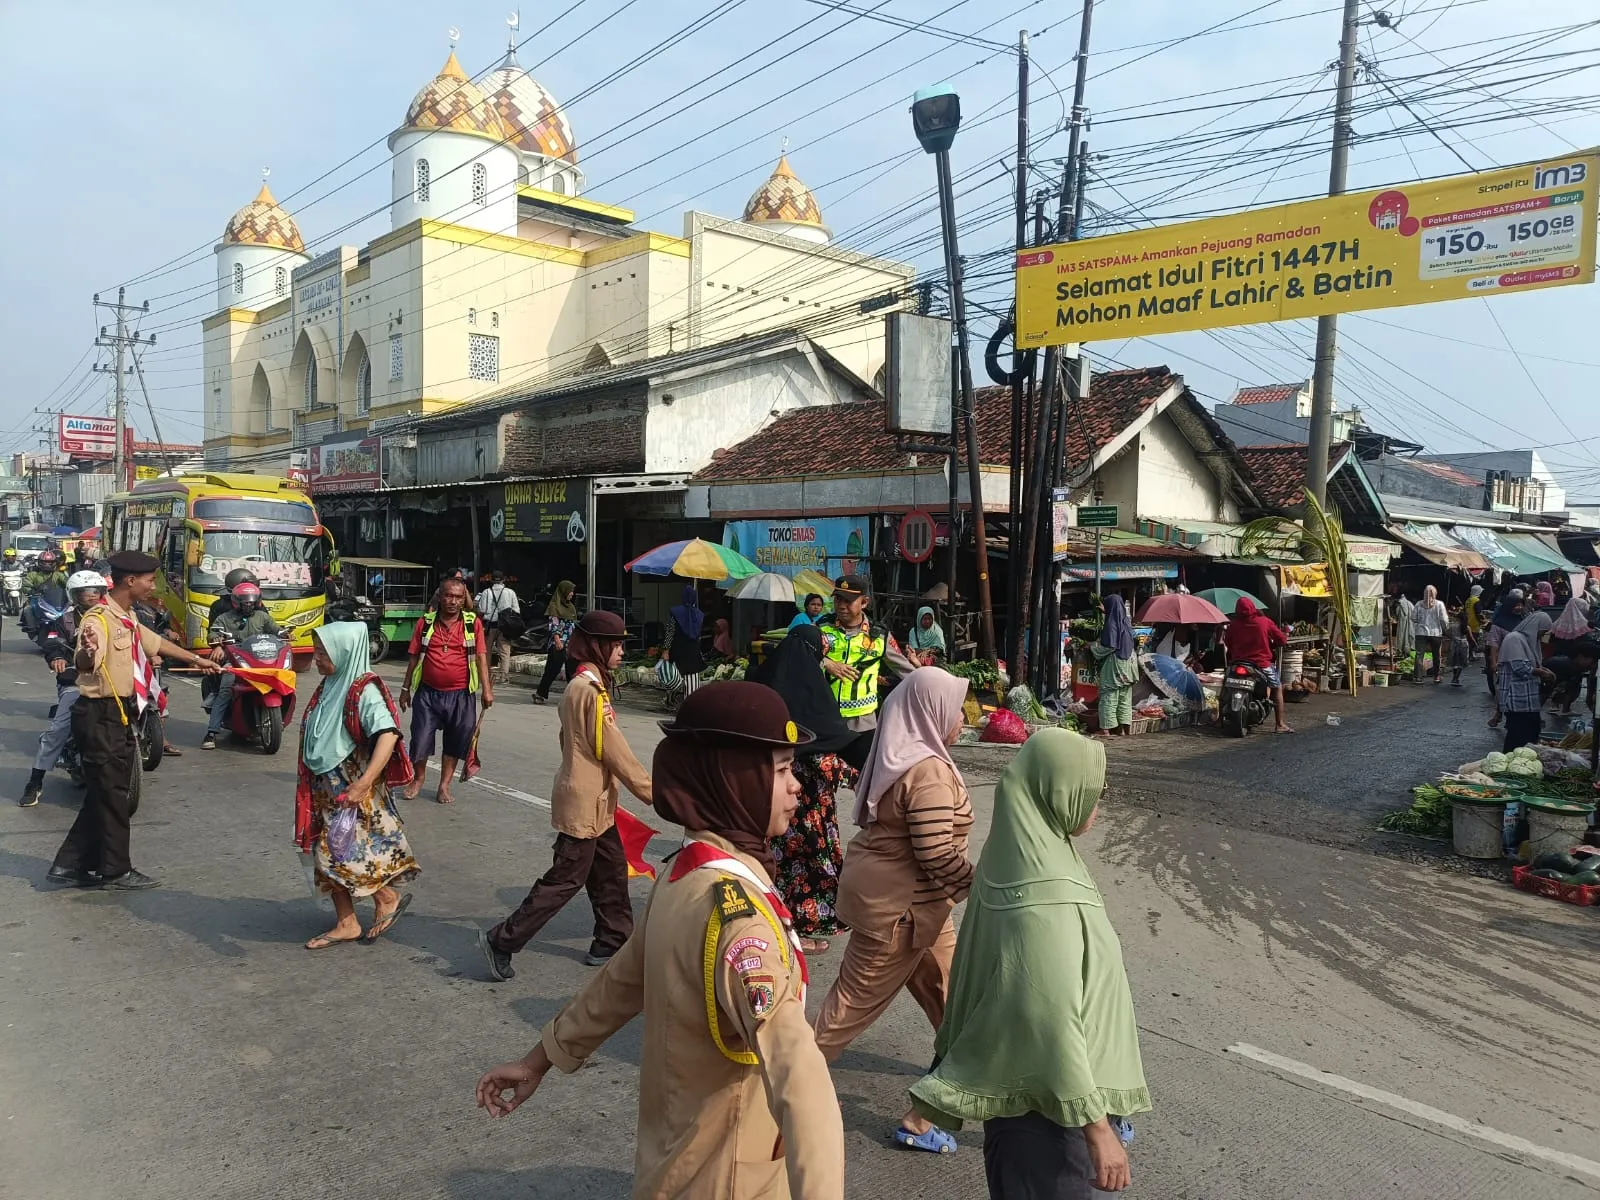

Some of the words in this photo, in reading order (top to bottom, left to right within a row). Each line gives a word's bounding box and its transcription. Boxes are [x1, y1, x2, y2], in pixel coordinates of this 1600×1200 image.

[1478, 181, 1513, 194] Simpel
[1515, 178, 1529, 188] itu
[1555, 193, 1580, 203] Baru!
[1428, 216, 1451, 225] Paket
[1452, 209, 1492, 220] Ramadan
[1493, 200, 1542, 214] SATSPAM+
[1508, 219, 1549, 243] 150
[1550, 215, 1575, 229] GB
[1057, 265, 1076, 274] IM3
[1079, 255, 1138, 272] SATSPAM+
[1141, 245, 1197, 262] Amankan
[1201, 235, 1253, 253] Pejuang
[1256, 225, 1321, 243] Ramadan
[1426, 237, 1435, 245] Rp
[1437, 231, 1485, 257] 150
[1056, 269, 1152, 301] Selamat
[1159, 260, 1203, 287] Idul
[1212, 251, 1264, 280] Fitri
[1271, 238, 1360, 272] 1447H
[1473, 280, 1486, 288] Beli
[1505, 275, 1527, 283] Outlet
[1056, 303, 1131, 328] Mohon
[1138, 289, 1203, 317] Maaf
[1211, 281, 1280, 309] Lahir
[1286, 276, 1305, 299] &
[1314, 265, 1393, 296] Batin
[67, 419, 116, 432] Alfamar
[505, 483, 532, 505] DIANA
[534, 481, 567, 504] SILVER
[769, 527, 791, 542] TOKO
[792, 527, 816, 542] EMAS
[755, 545, 828, 566] SEMANGKA
[730, 939, 764, 958] BREBES
